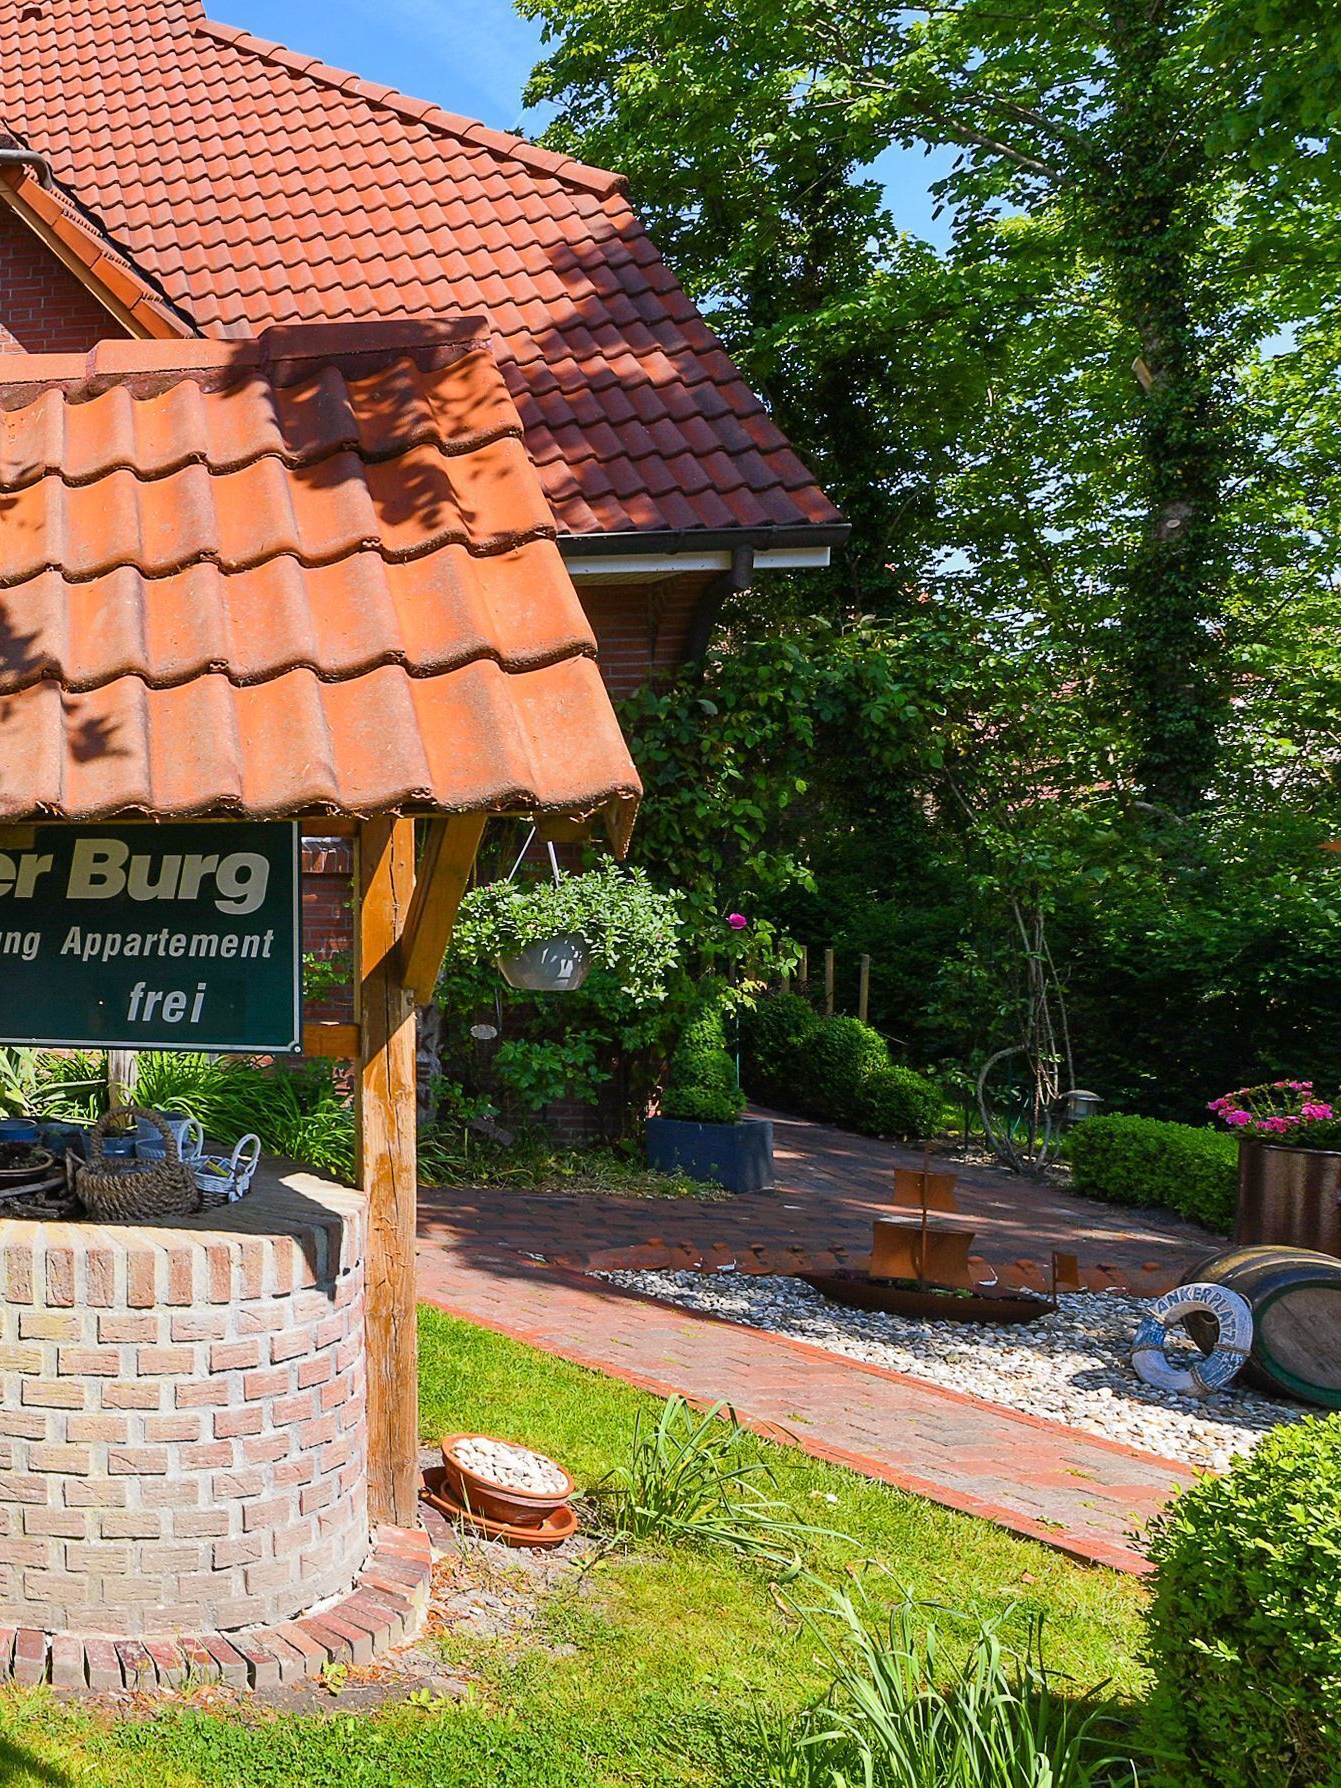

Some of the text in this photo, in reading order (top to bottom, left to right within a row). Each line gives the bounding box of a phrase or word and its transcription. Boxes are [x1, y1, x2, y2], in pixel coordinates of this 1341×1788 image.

[66, 838, 270, 915] Burg
[60, 926, 274, 962] Appartement
[127, 981, 207, 1024] frei
[1157, 1286, 1237, 1344] ANKERPLATZ
